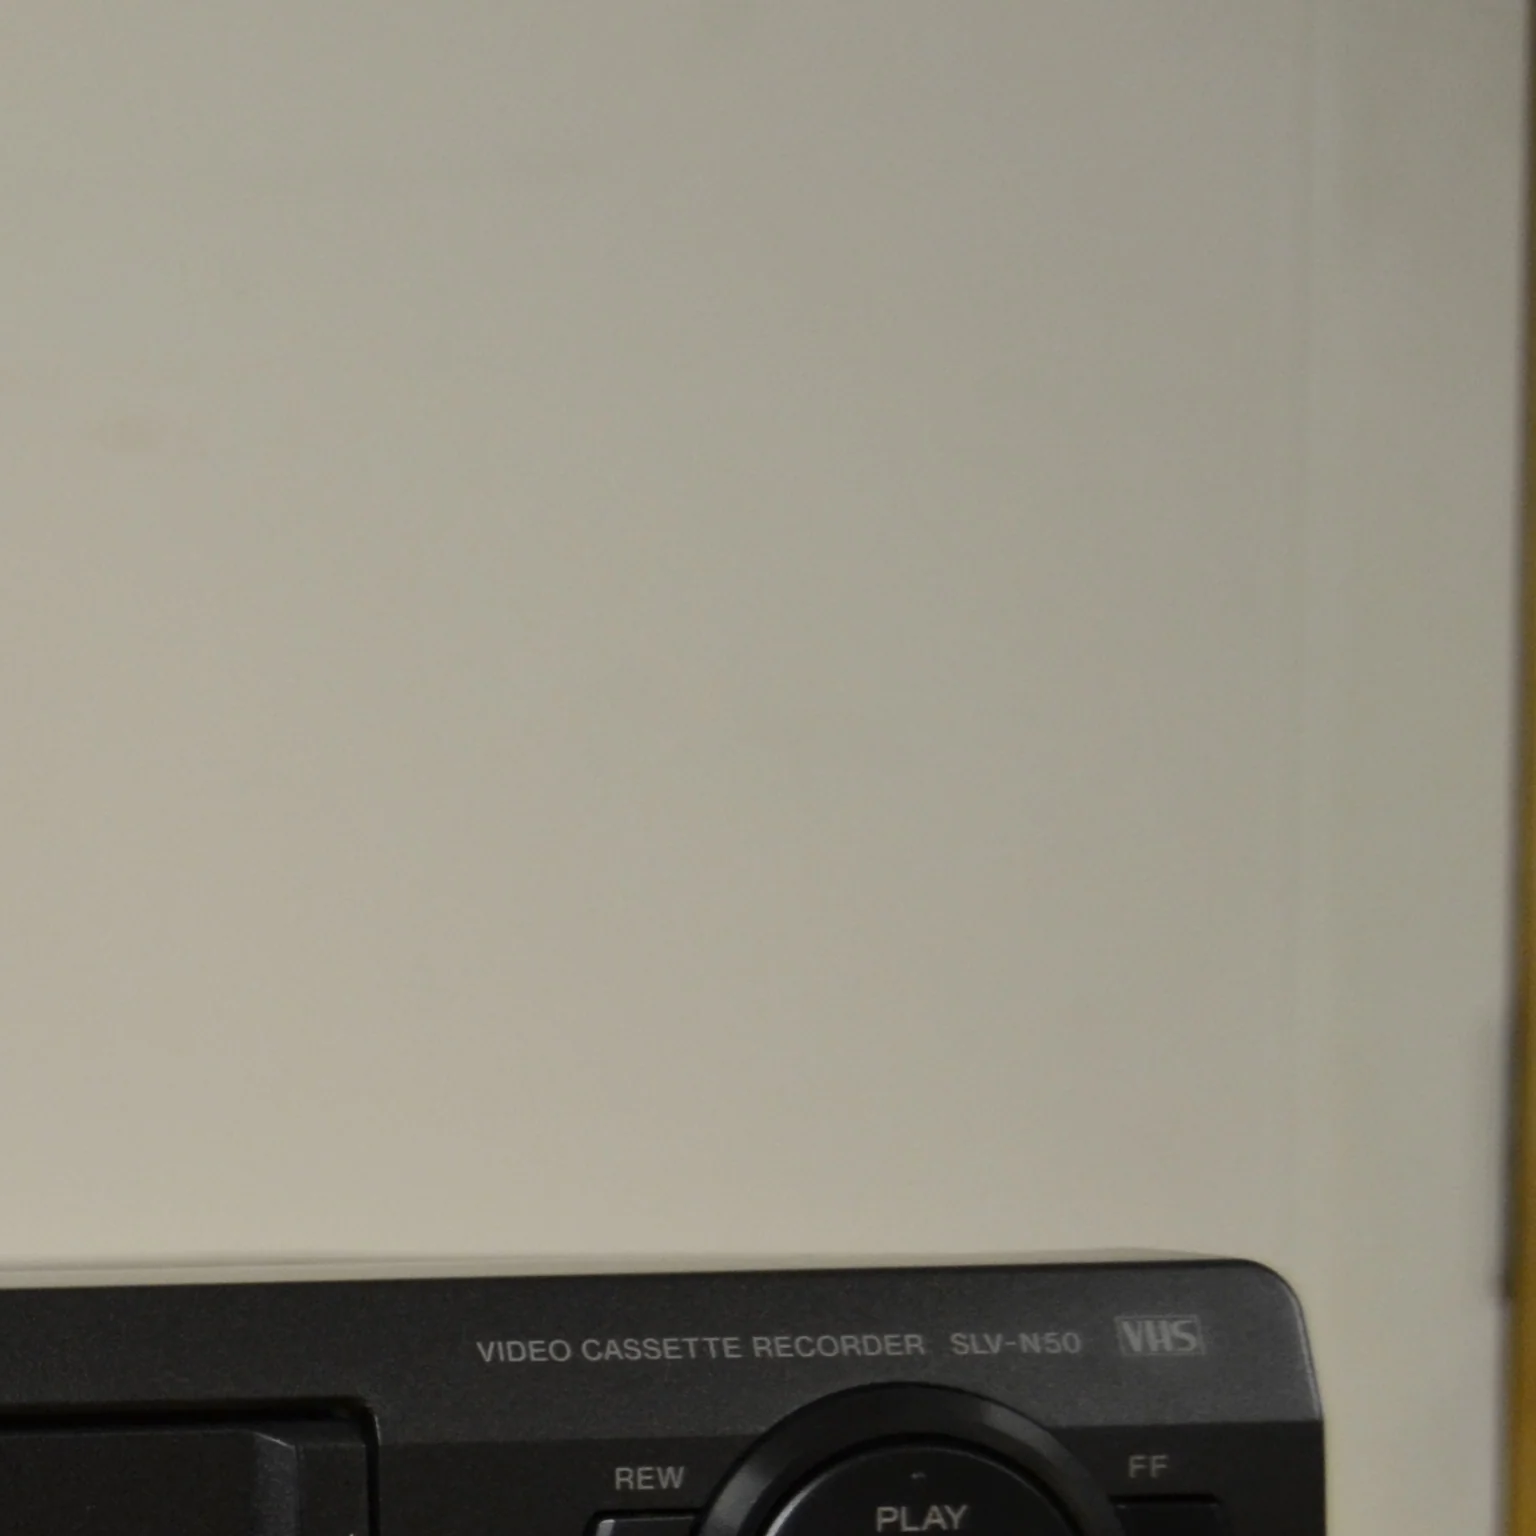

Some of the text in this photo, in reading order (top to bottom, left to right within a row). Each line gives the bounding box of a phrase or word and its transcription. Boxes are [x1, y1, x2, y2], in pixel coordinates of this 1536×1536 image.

[476, 1335, 924, 1362] VIDEO CASSETTE RECORDER
[951, 1331, 1081, 1356] SLV-N50
[1123, 1319, 1198, 1353] VHS
[615, 1467, 684, 1491] REW
[1130, 1455, 1168, 1478] FF
[876, 1505, 968, 1532] PLAY
